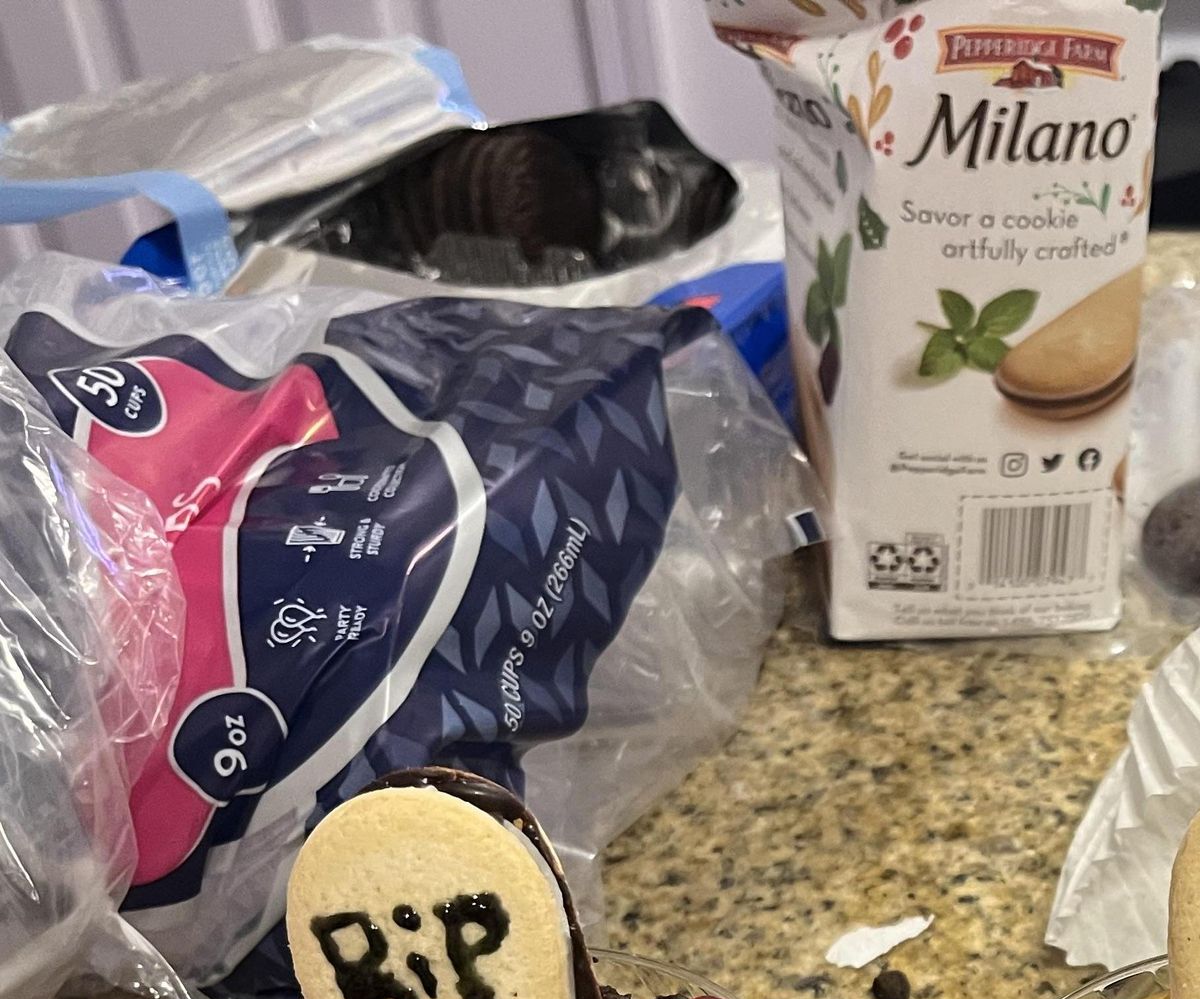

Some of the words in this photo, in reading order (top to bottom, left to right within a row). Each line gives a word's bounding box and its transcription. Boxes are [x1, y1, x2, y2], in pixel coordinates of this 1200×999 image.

[904, 93, 1132, 170] Milano
[900, 199, 971, 227] Savor
[979, 213, 995, 229] a
[1002, 207, 1079, 230] cookie
[941, 237, 1029, 266] artfully
[76, 366, 126, 407] 50
[124, 385, 147, 420] CUPS
[349, 524, 370, 559] STRONG
[366, 521, 386, 556] STURDY
[334, 604, 352, 641] PARTY
[532, 596, 555, 630] OZ
[521, 629, 536, 648] 9
[501, 647, 525, 701] CUPS
[504, 702, 523, 732] 50
[213, 748, 248, 777] 9
